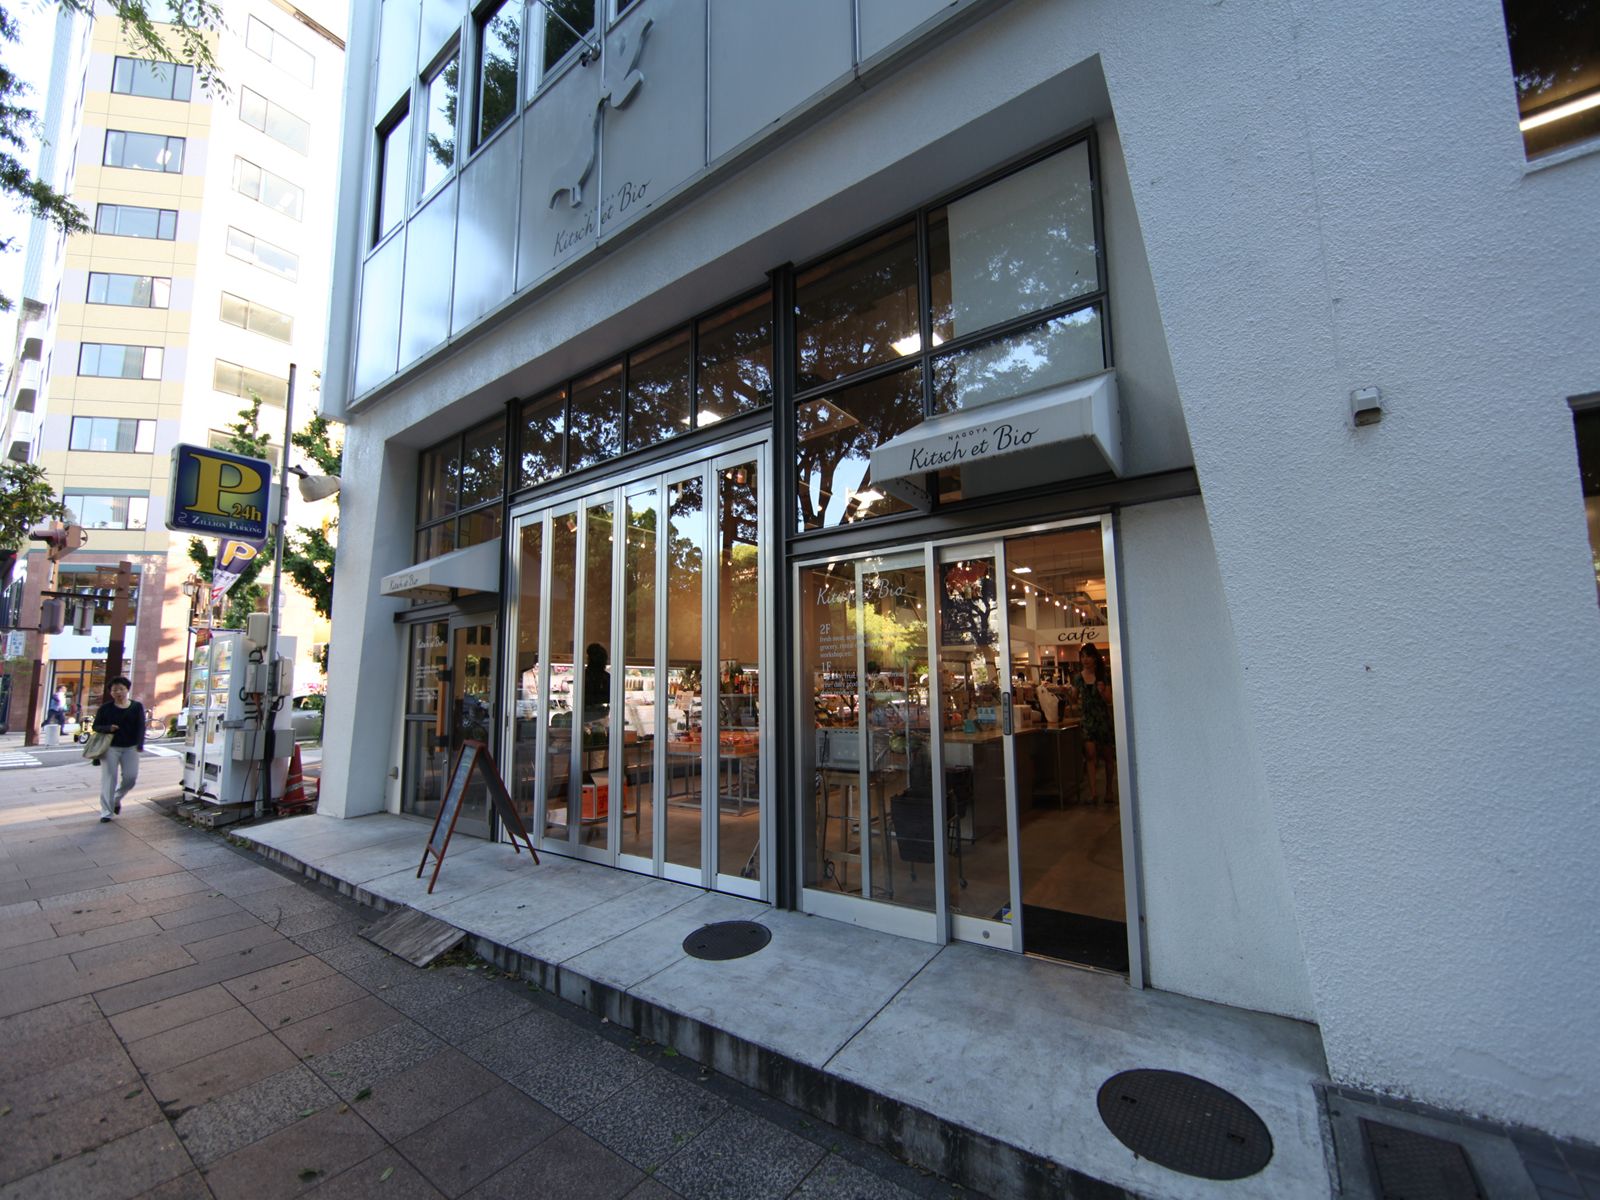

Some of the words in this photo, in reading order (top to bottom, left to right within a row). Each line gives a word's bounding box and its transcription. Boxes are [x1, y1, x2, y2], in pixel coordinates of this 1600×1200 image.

[554, 215, 595, 257] Kitsch
[601, 206, 614, 225] et
[617, 178, 653, 213] Bio
[909, 441, 966, 471] Kitsch
[971, 439, 990, 456] et
[993, 424, 1040, 451] Bio
[185, 453, 263, 517] P
[231, 503, 263, 522] 24h
[878, 578, 906, 598] Bio
[819, 623, 831, 635] 2F
[1058, 626, 1100, 643] café
